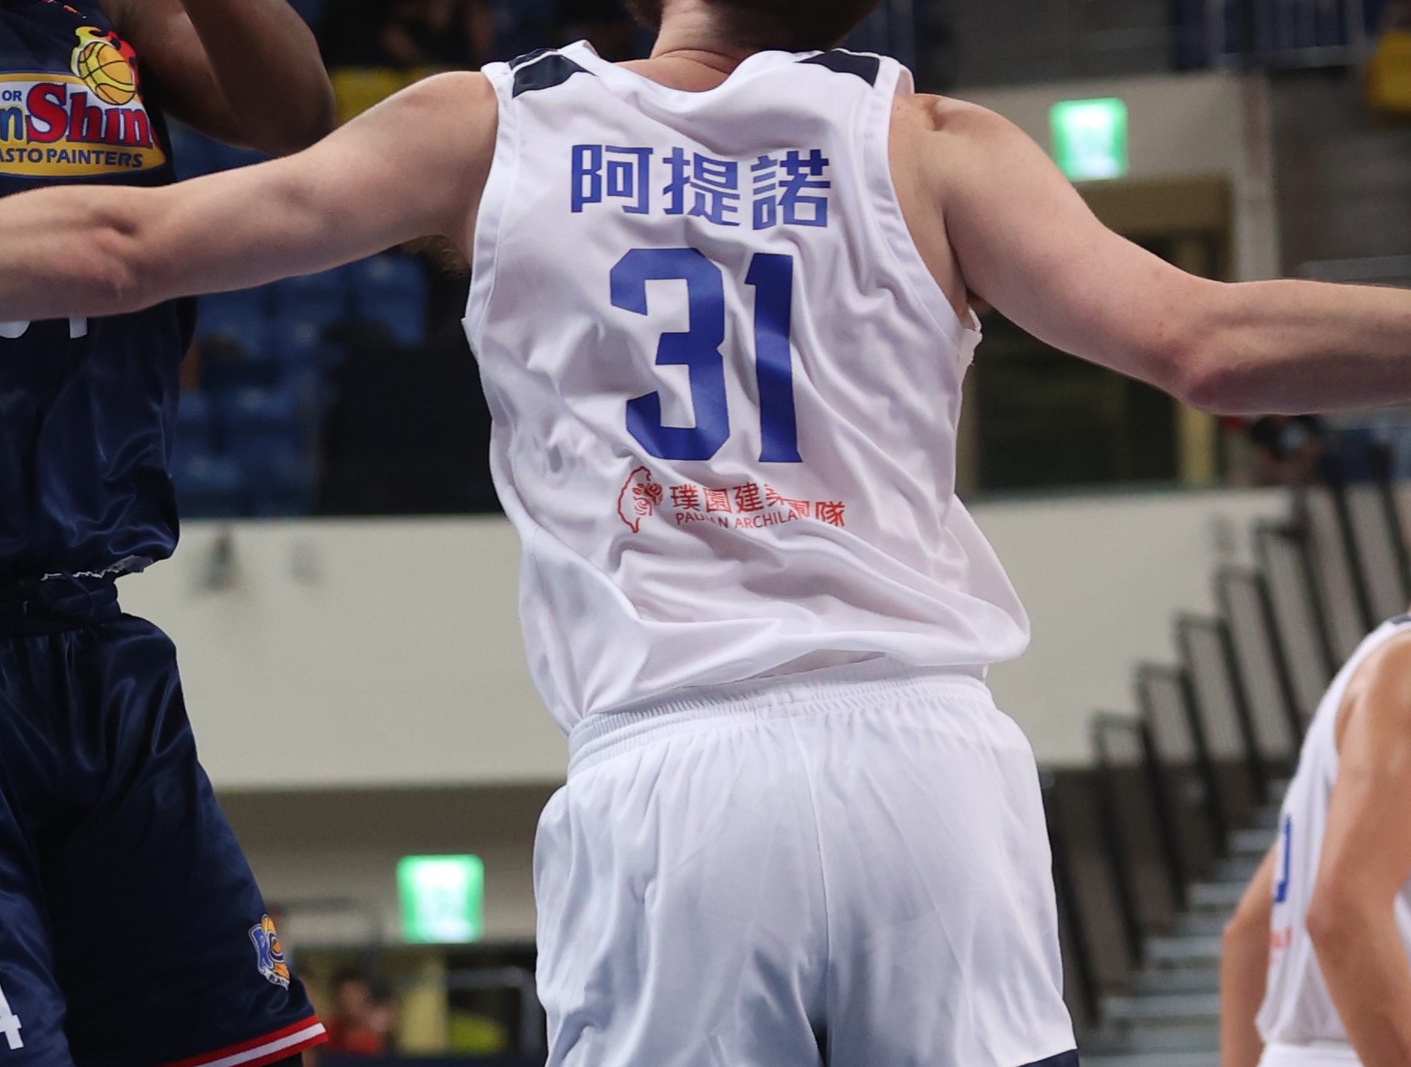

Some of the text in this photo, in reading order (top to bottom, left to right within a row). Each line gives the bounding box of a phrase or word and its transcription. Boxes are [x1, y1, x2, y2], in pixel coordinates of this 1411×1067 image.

[1, 89, 23, 103] OR
[25, 82, 160, 150] Shin
[45, 148, 144, 169] PAINTERS
[571, 144, 832, 231] 阿提諾
[609, 247, 804, 464] 31
[674, 510, 730, 529] PAUN
